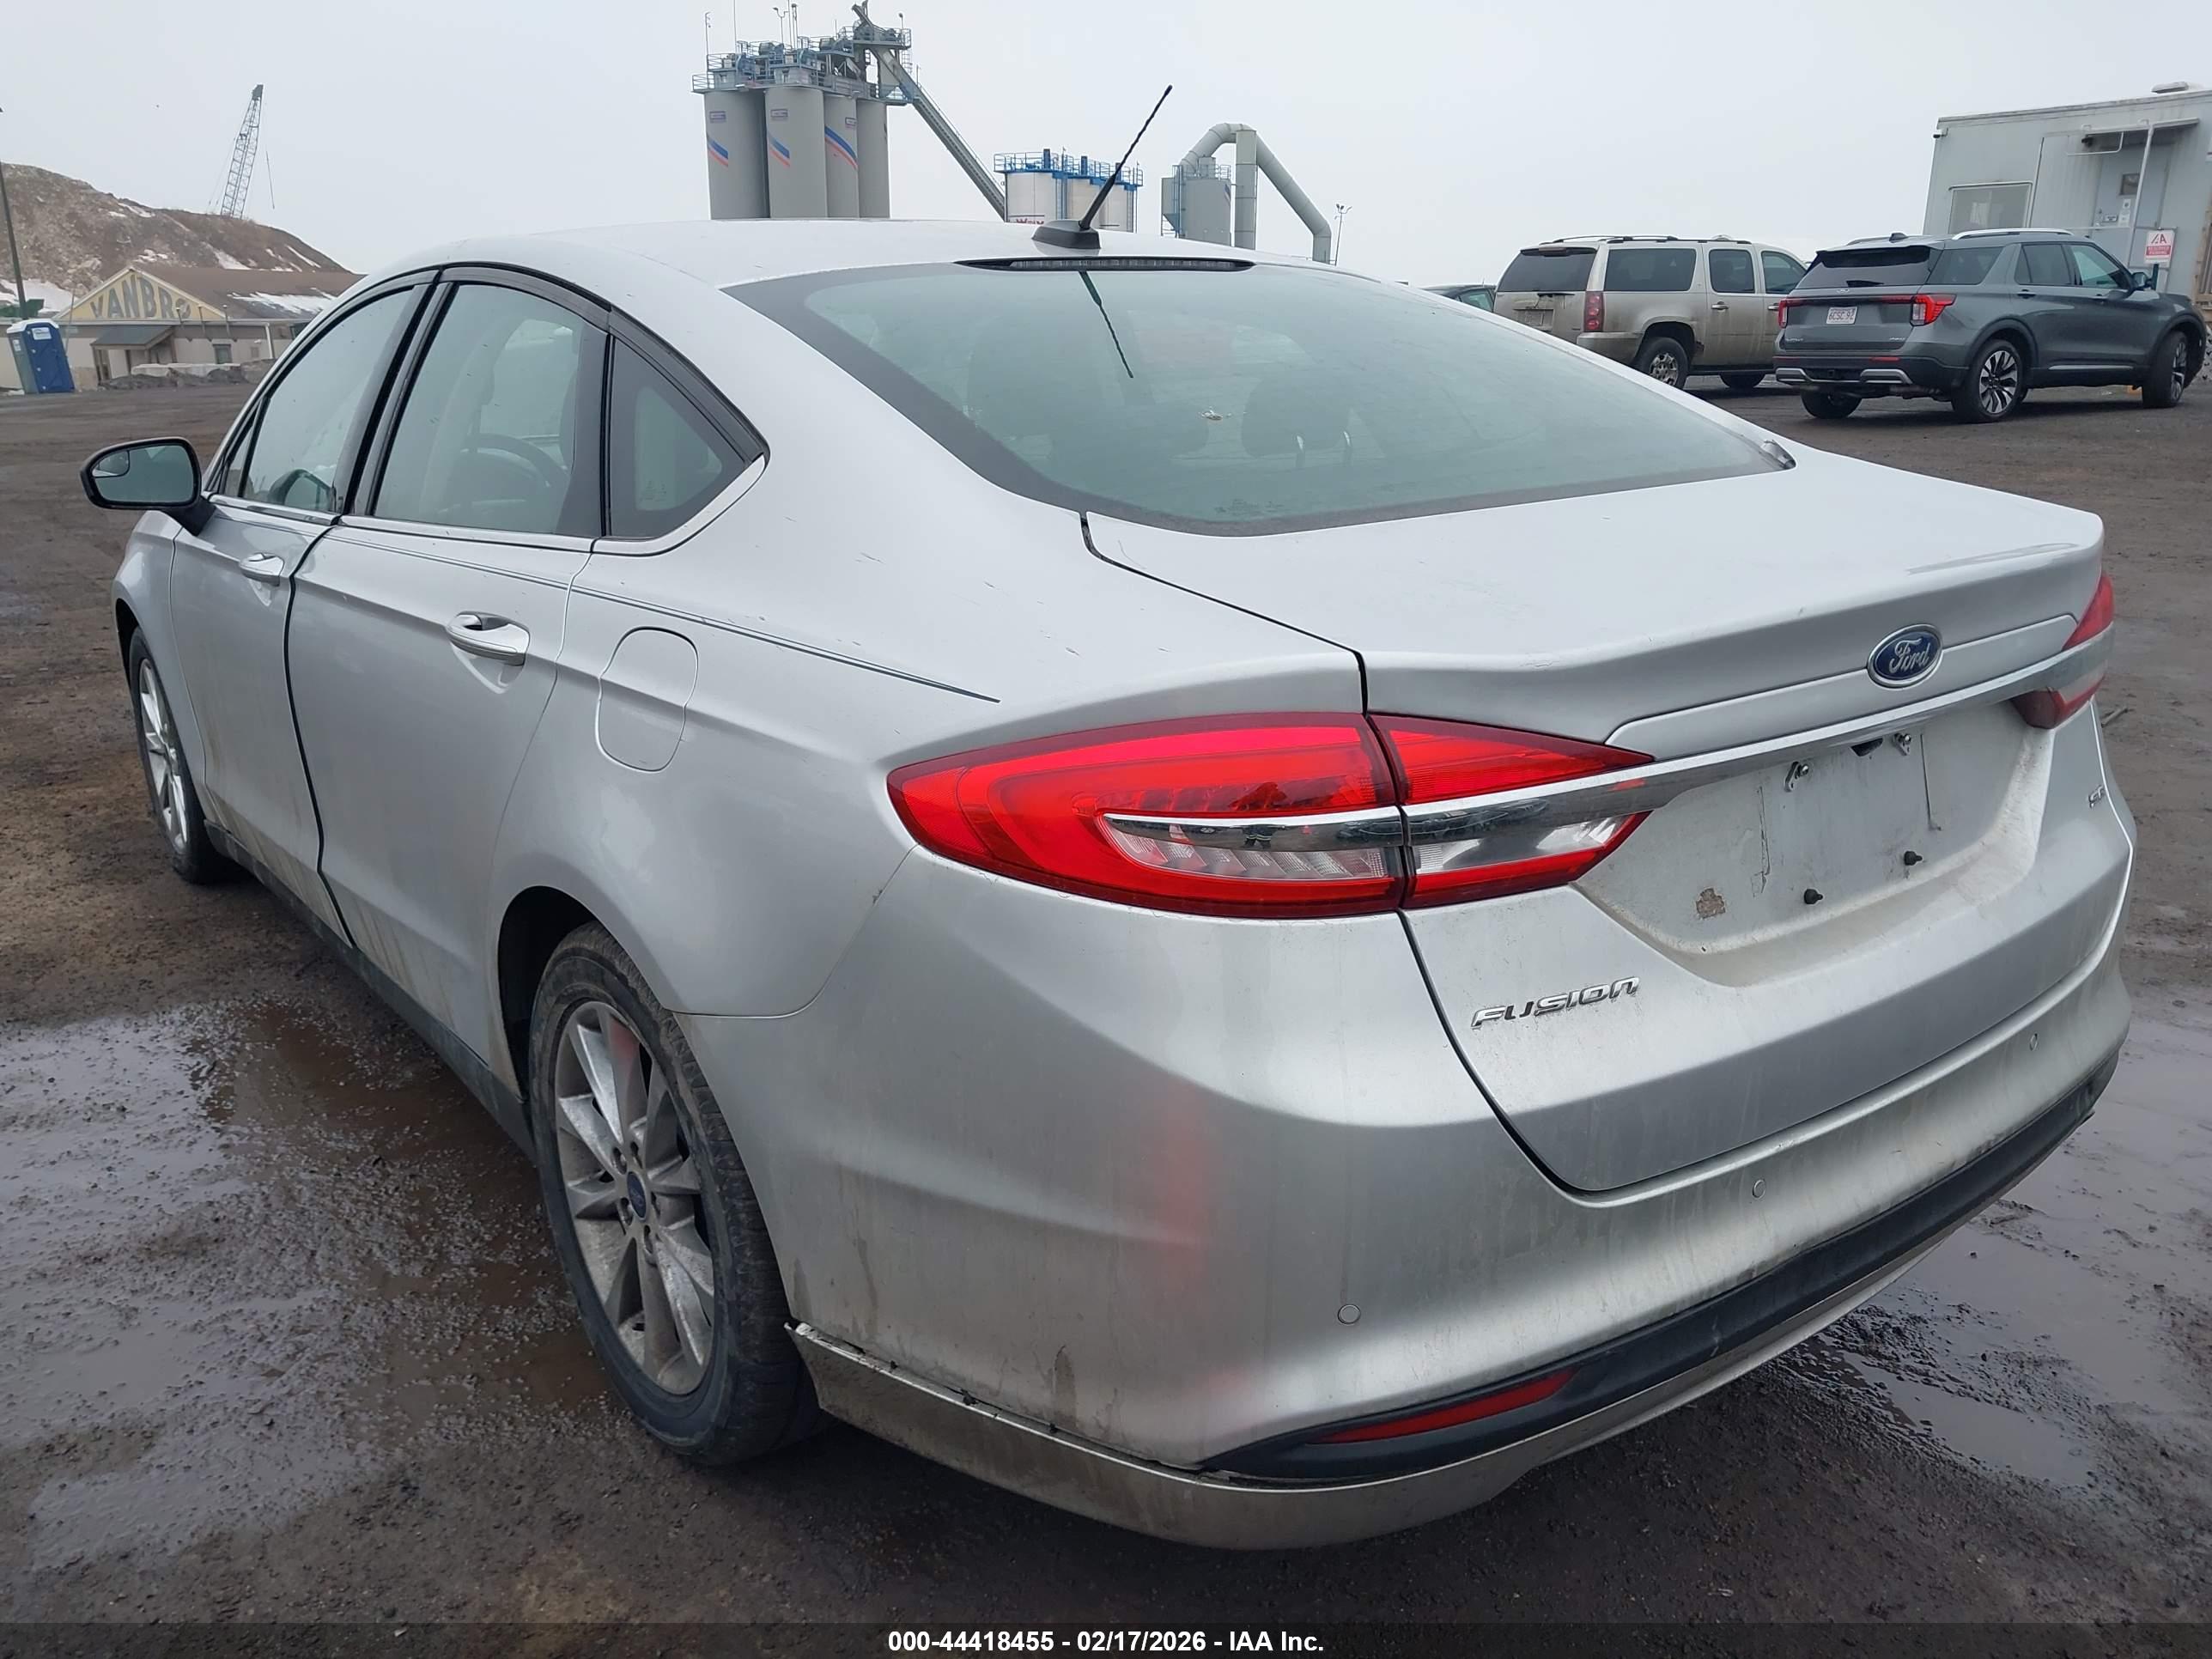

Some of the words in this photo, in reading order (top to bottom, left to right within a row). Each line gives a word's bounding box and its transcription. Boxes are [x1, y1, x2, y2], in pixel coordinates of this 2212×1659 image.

[89, 274, 191, 319] VANBRO
[1888, 637, 1931, 673] Ford
[1470, 975, 1640, 1029] FUSION
